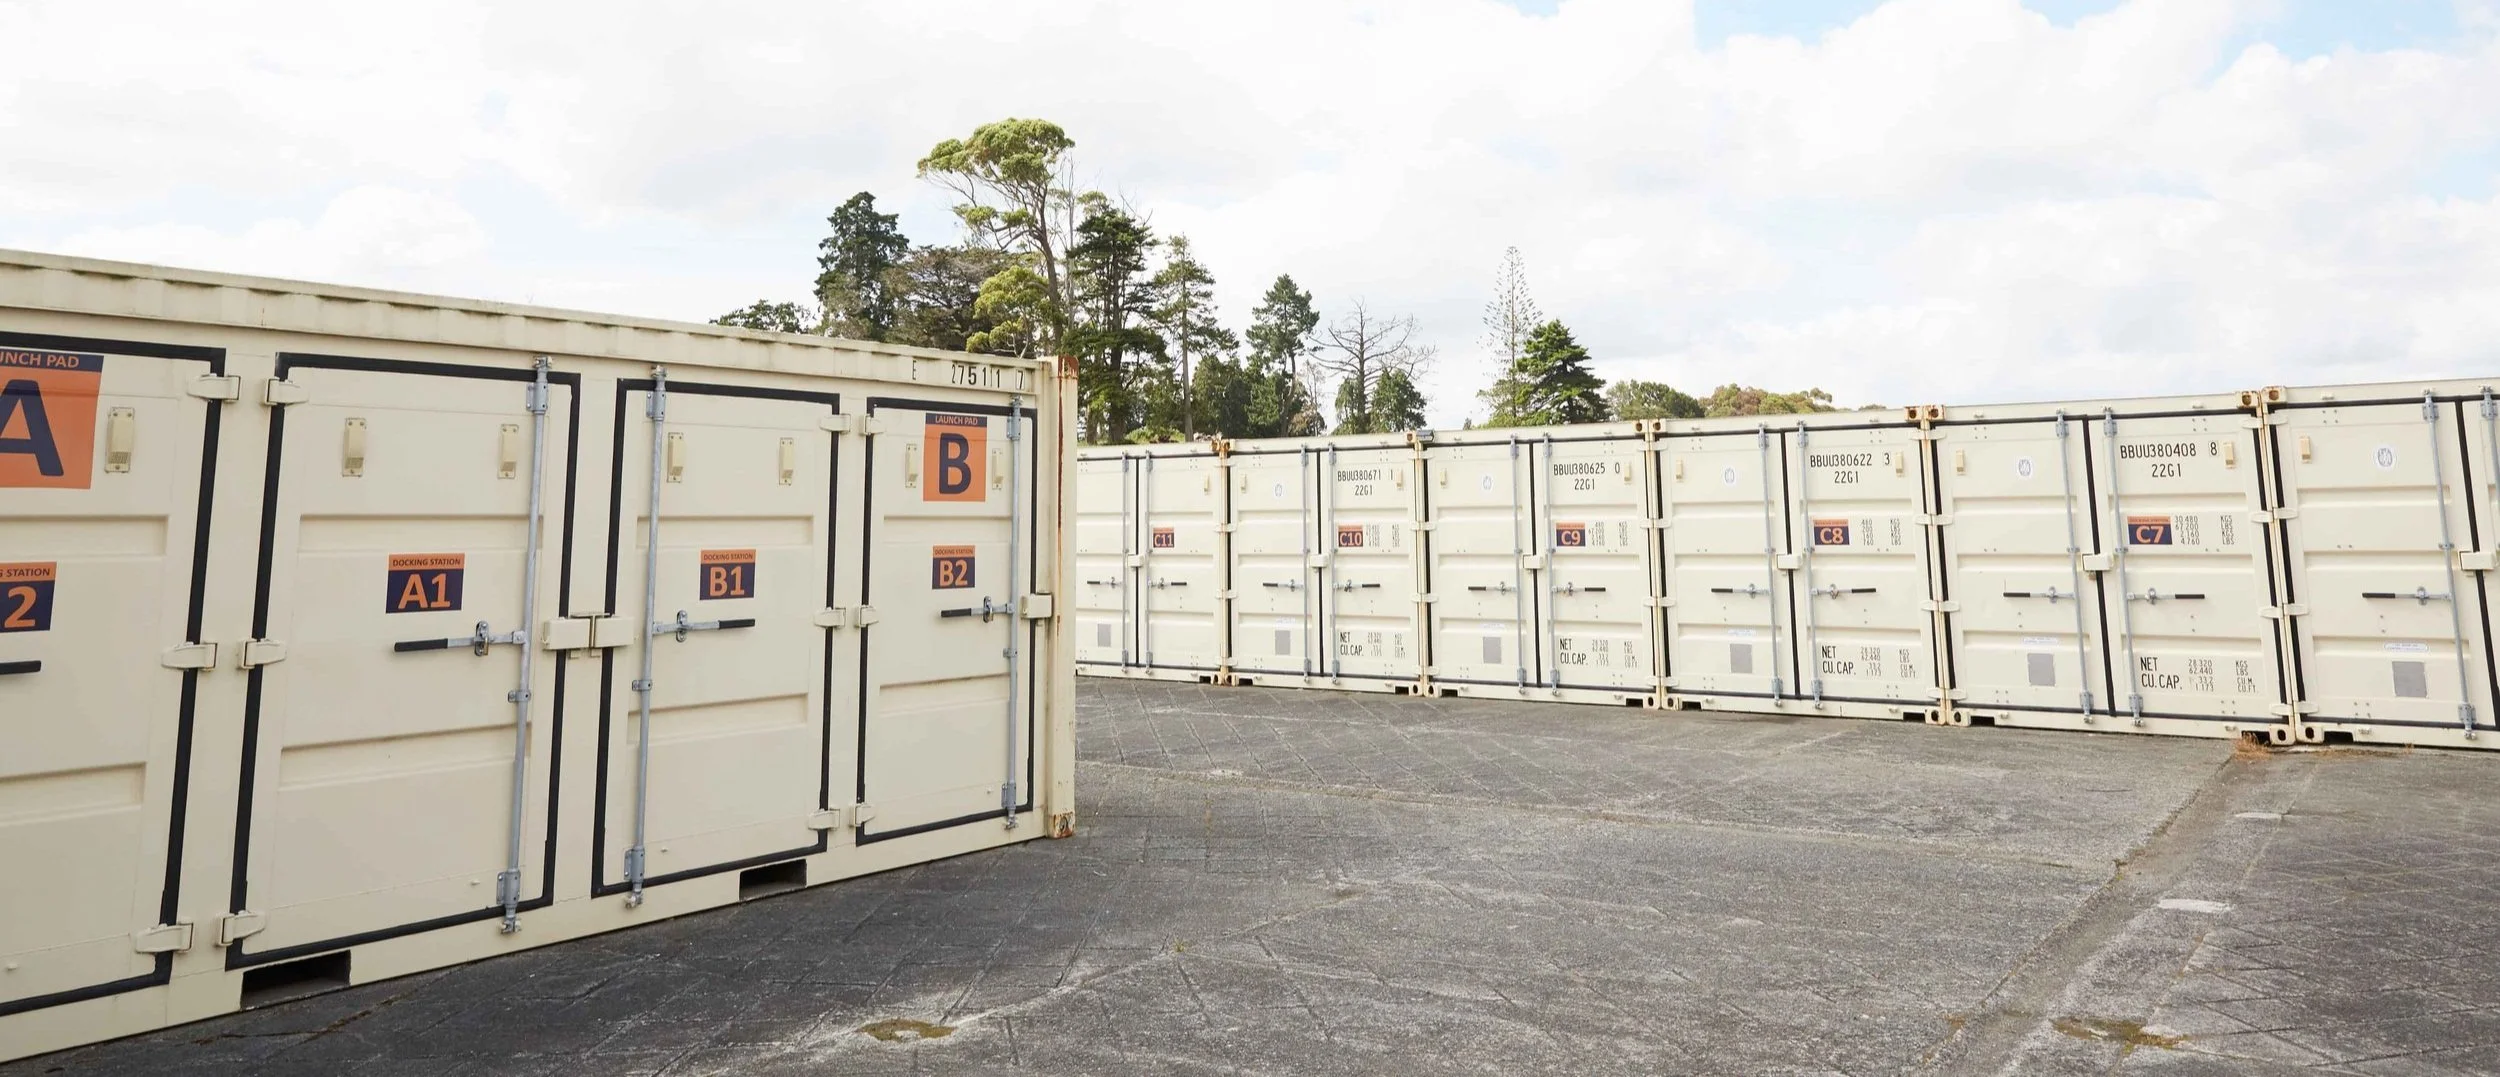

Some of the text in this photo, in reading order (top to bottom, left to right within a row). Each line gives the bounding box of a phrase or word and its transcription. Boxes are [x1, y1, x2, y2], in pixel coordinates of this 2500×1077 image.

[46, 354, 79, 368] PAD
[0, 379, 64, 476] A
[935, 415, 978, 426] LAUNCH PAD
[2120, 441, 2217, 459] BBUU380408 8
[939, 433, 972, 494] B
[1810, 452, 1890, 468] BBUU380622 3
[1337, 469, 1381, 481] BBUU380671
[1553, 462, 1606, 476] BBUU380625
[2151, 463, 2181, 478] 22G1
[1574, 478, 1595, 490] 22G1
[1834, 470, 1859, 484] 22G1
[1155, 534, 1173, 546] C11
[1340, 532, 1362, 546] C10
[1561, 530, 1581, 545] C9
[1820, 527, 1844, 544] C8
[2136, 525, 2164, 544] C7
[6, 568, 50, 577] STATION
[940, 559, 968, 587] B2
[710, 566, 745, 596] B1
[398, 573, 451, 609] A1
[4, 586, 37, 628] 2
[1340, 631, 1350, 643] NET
[1559, 638, 1572, 651] NET
[1821, 645, 1836, 659] NET
[2140, 656, 2158, 672] NET
